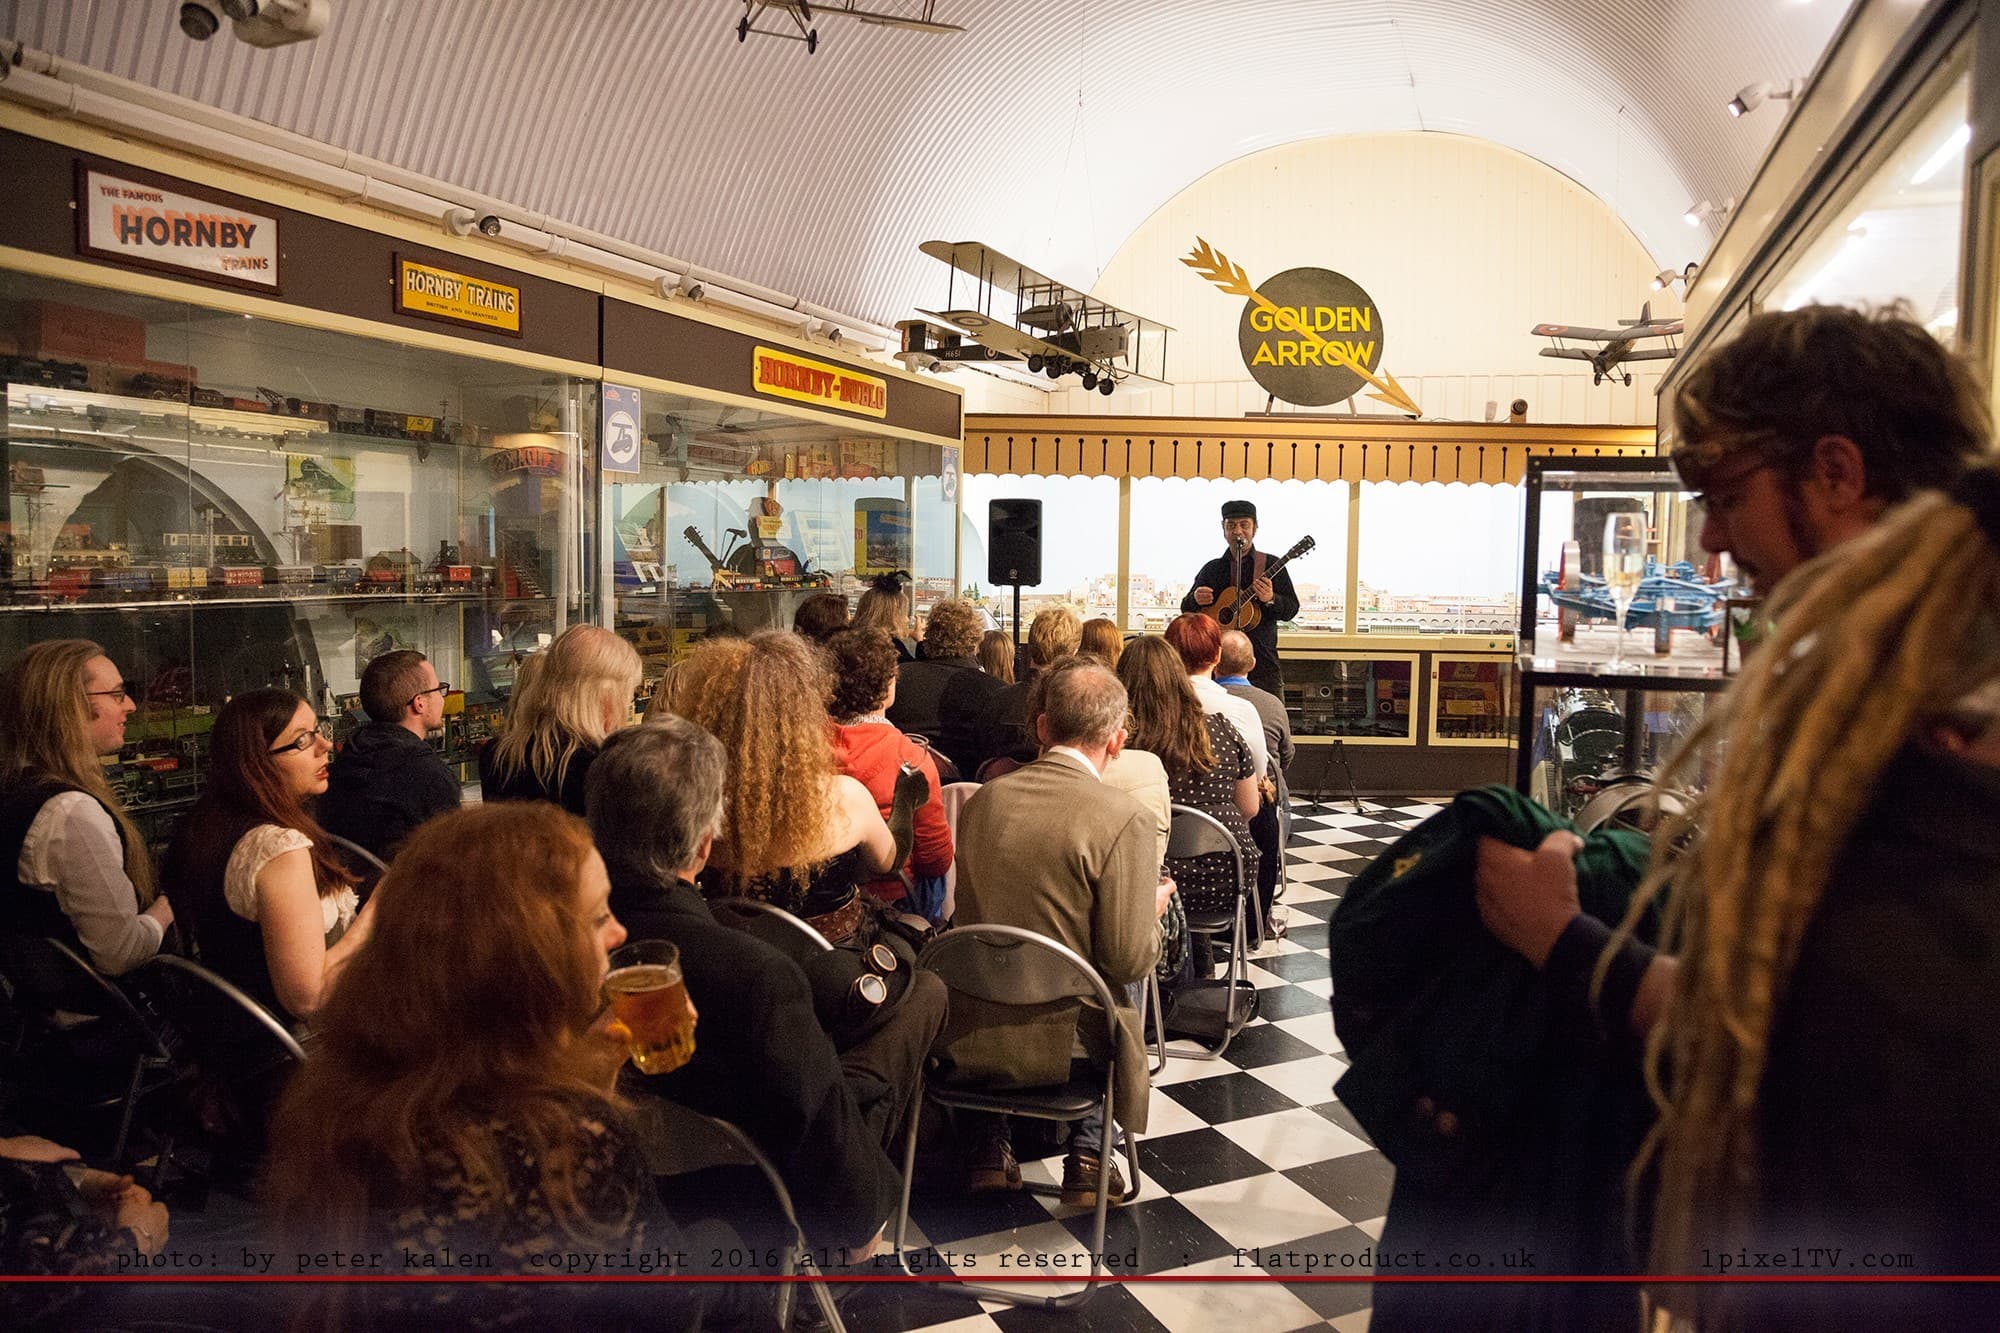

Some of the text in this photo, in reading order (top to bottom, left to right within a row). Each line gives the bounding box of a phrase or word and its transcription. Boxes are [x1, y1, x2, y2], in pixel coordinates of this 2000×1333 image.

[100, 186, 164, 203] THE FAMOUS
[120, 214, 257, 249] HORNBY
[222, 256, 268, 271] TRAINS
[406, 269, 516, 314] HORNBY TRAINS
[1250, 306, 1371, 333] GOLDEN
[1251, 340, 1375, 367] ARROW
